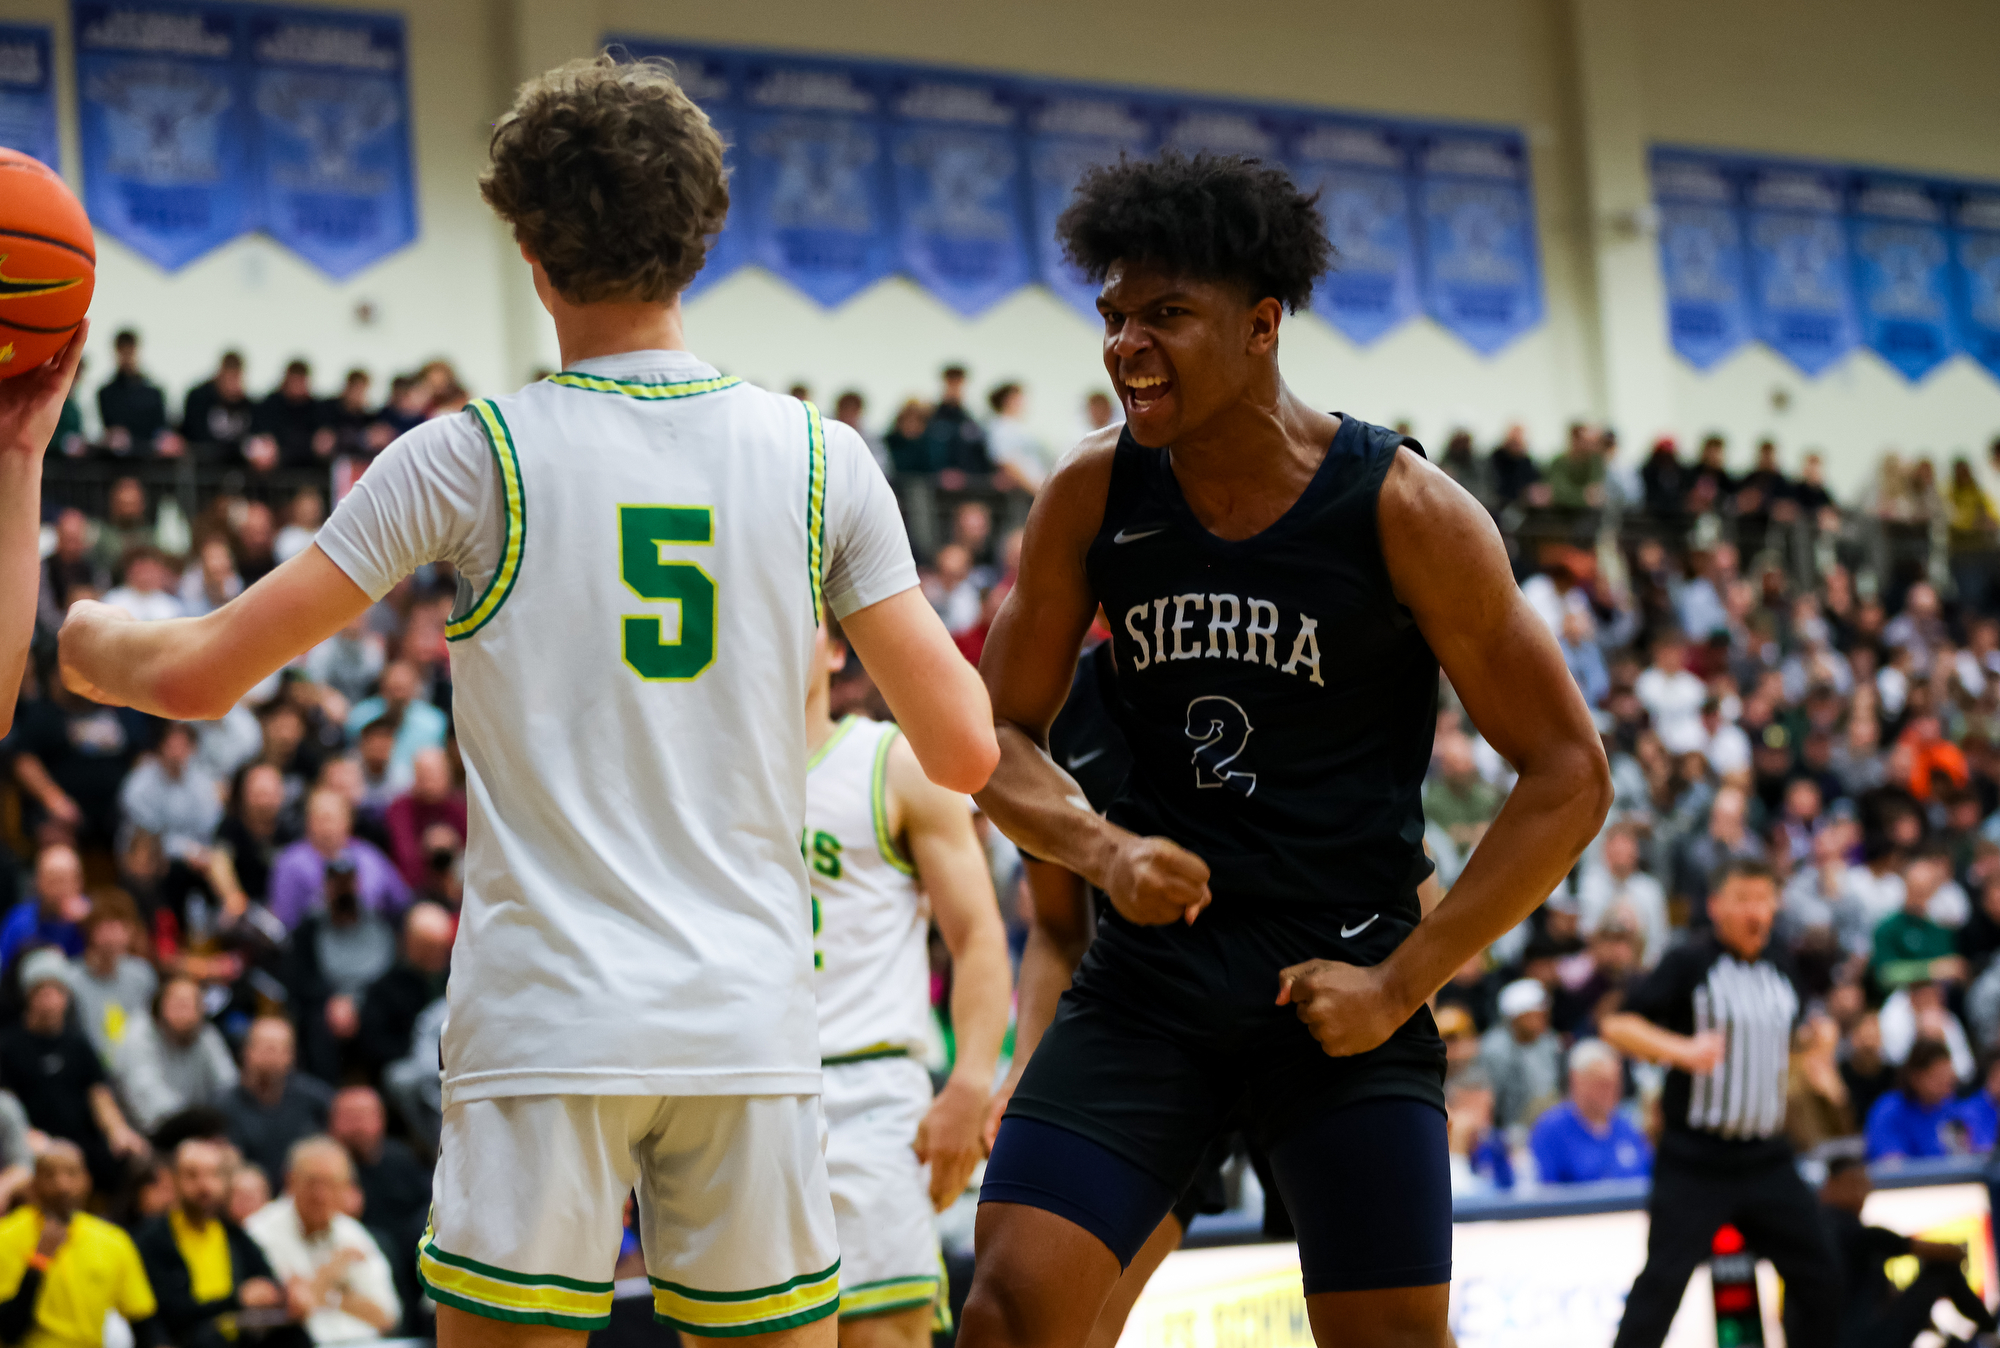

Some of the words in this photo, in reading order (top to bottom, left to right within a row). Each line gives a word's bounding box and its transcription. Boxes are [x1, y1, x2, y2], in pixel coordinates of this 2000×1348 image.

[616, 503, 719, 682] 5
[1125, 593, 1325, 687] SIERRA
[1185, 695, 1256, 797] 2
[801, 827, 842, 880] S
